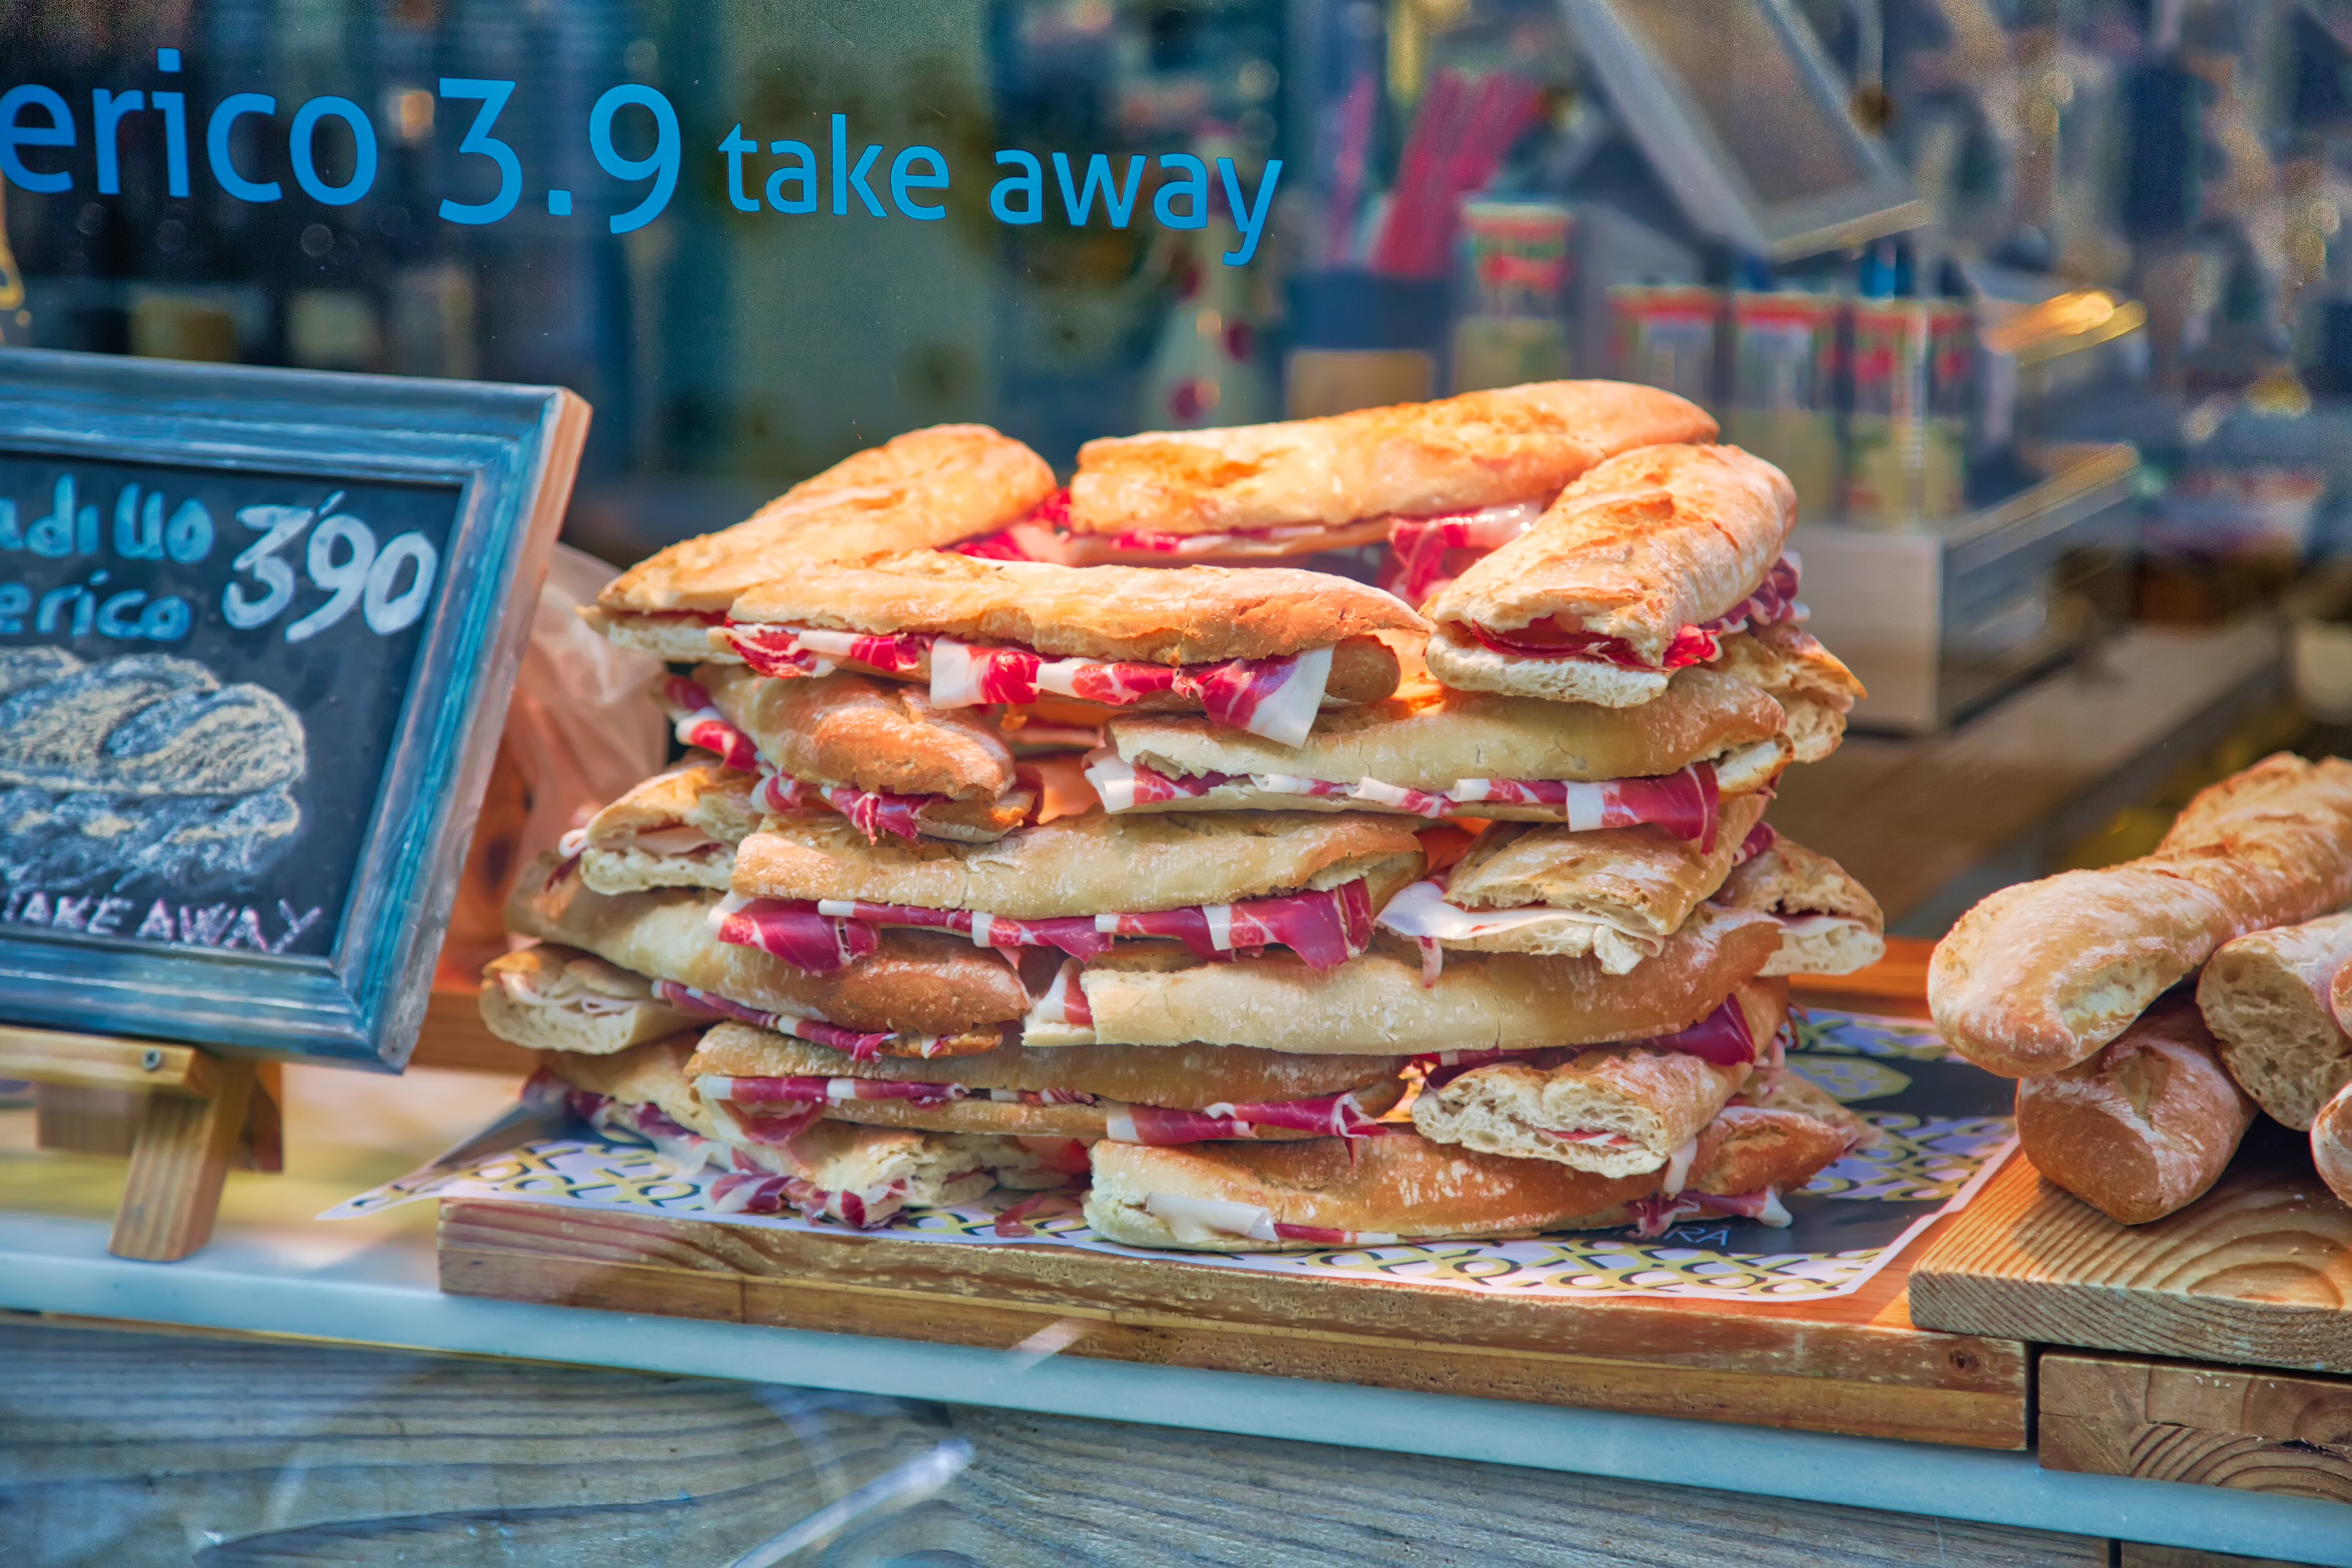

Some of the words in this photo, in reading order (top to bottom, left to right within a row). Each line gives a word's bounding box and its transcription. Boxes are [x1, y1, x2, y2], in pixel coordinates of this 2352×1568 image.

[0, 48, 378, 206] erico
[438, 78, 681, 234] 3.9
[717, 113, 950, 220] take
[989, 149, 1283, 267] away
[136, 898, 323, 954] AWAY
